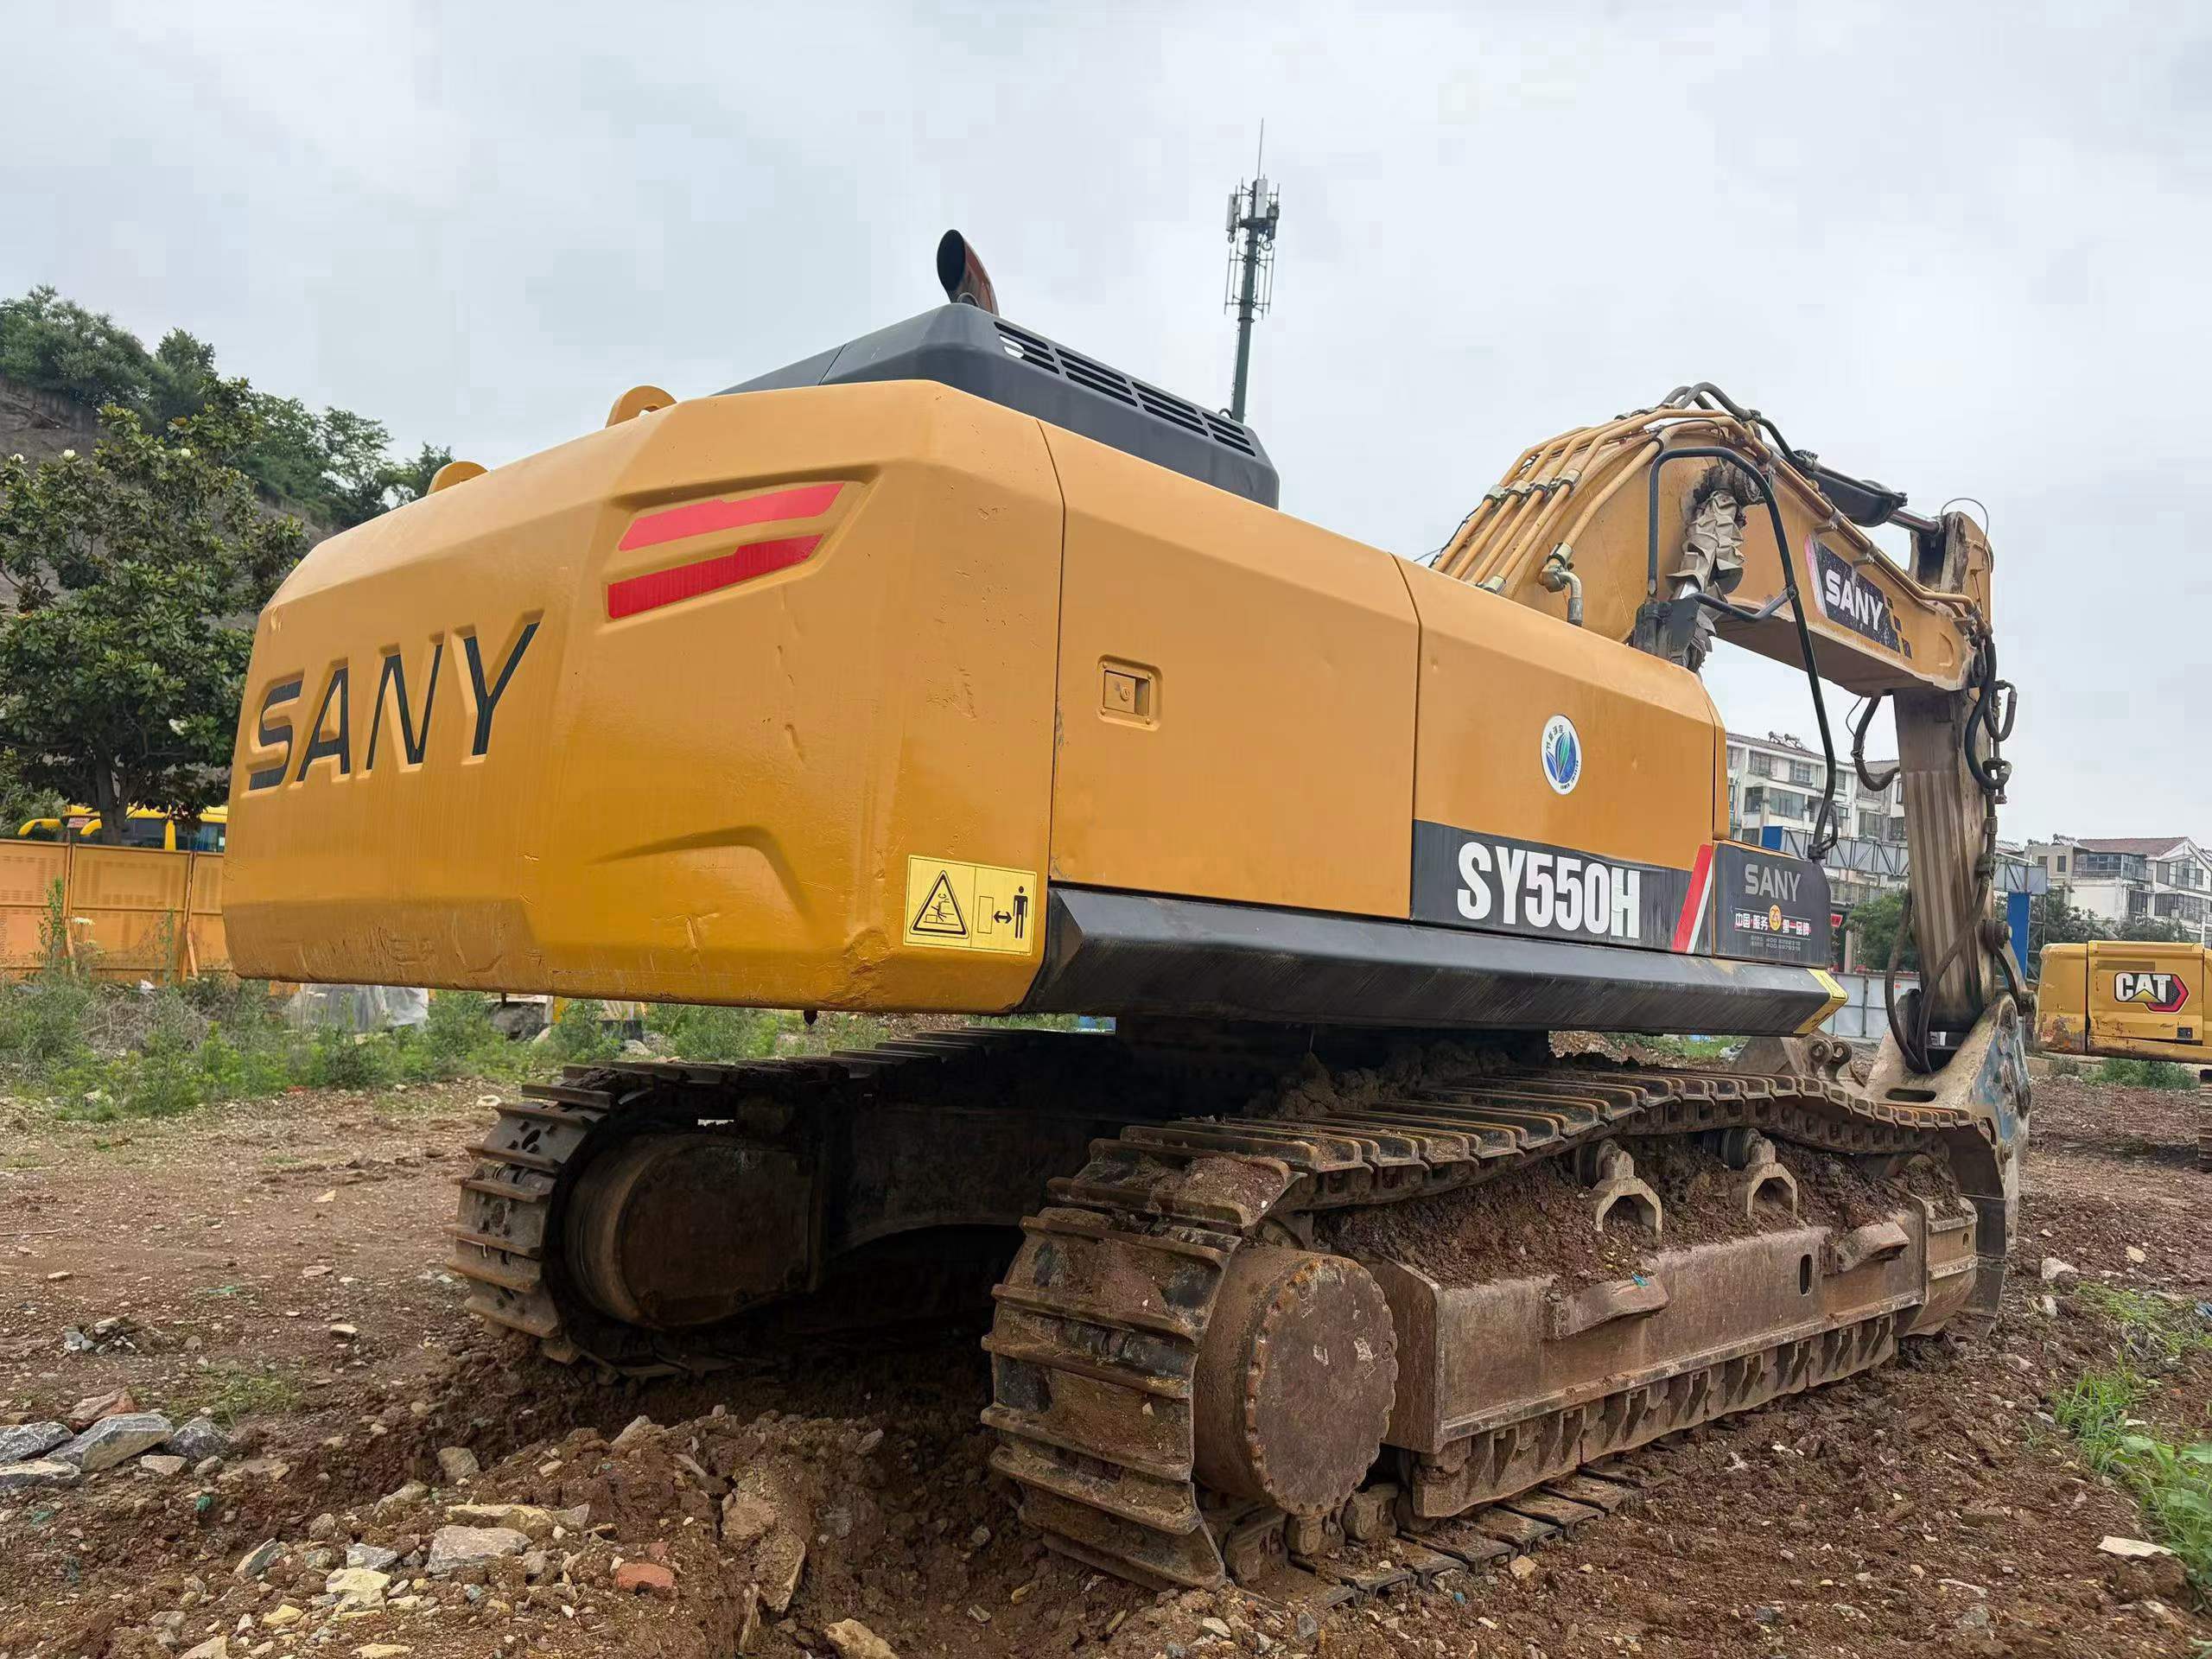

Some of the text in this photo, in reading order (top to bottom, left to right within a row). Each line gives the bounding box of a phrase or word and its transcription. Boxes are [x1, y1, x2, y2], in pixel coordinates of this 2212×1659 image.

[1826, 569, 1884, 632] SANY
[247, 618, 542, 791] SANY
[1457, 842, 1641, 939] SY550H
[1745, 864, 1802, 902] SANY
[2116, 972, 2171, 1003] CAT
